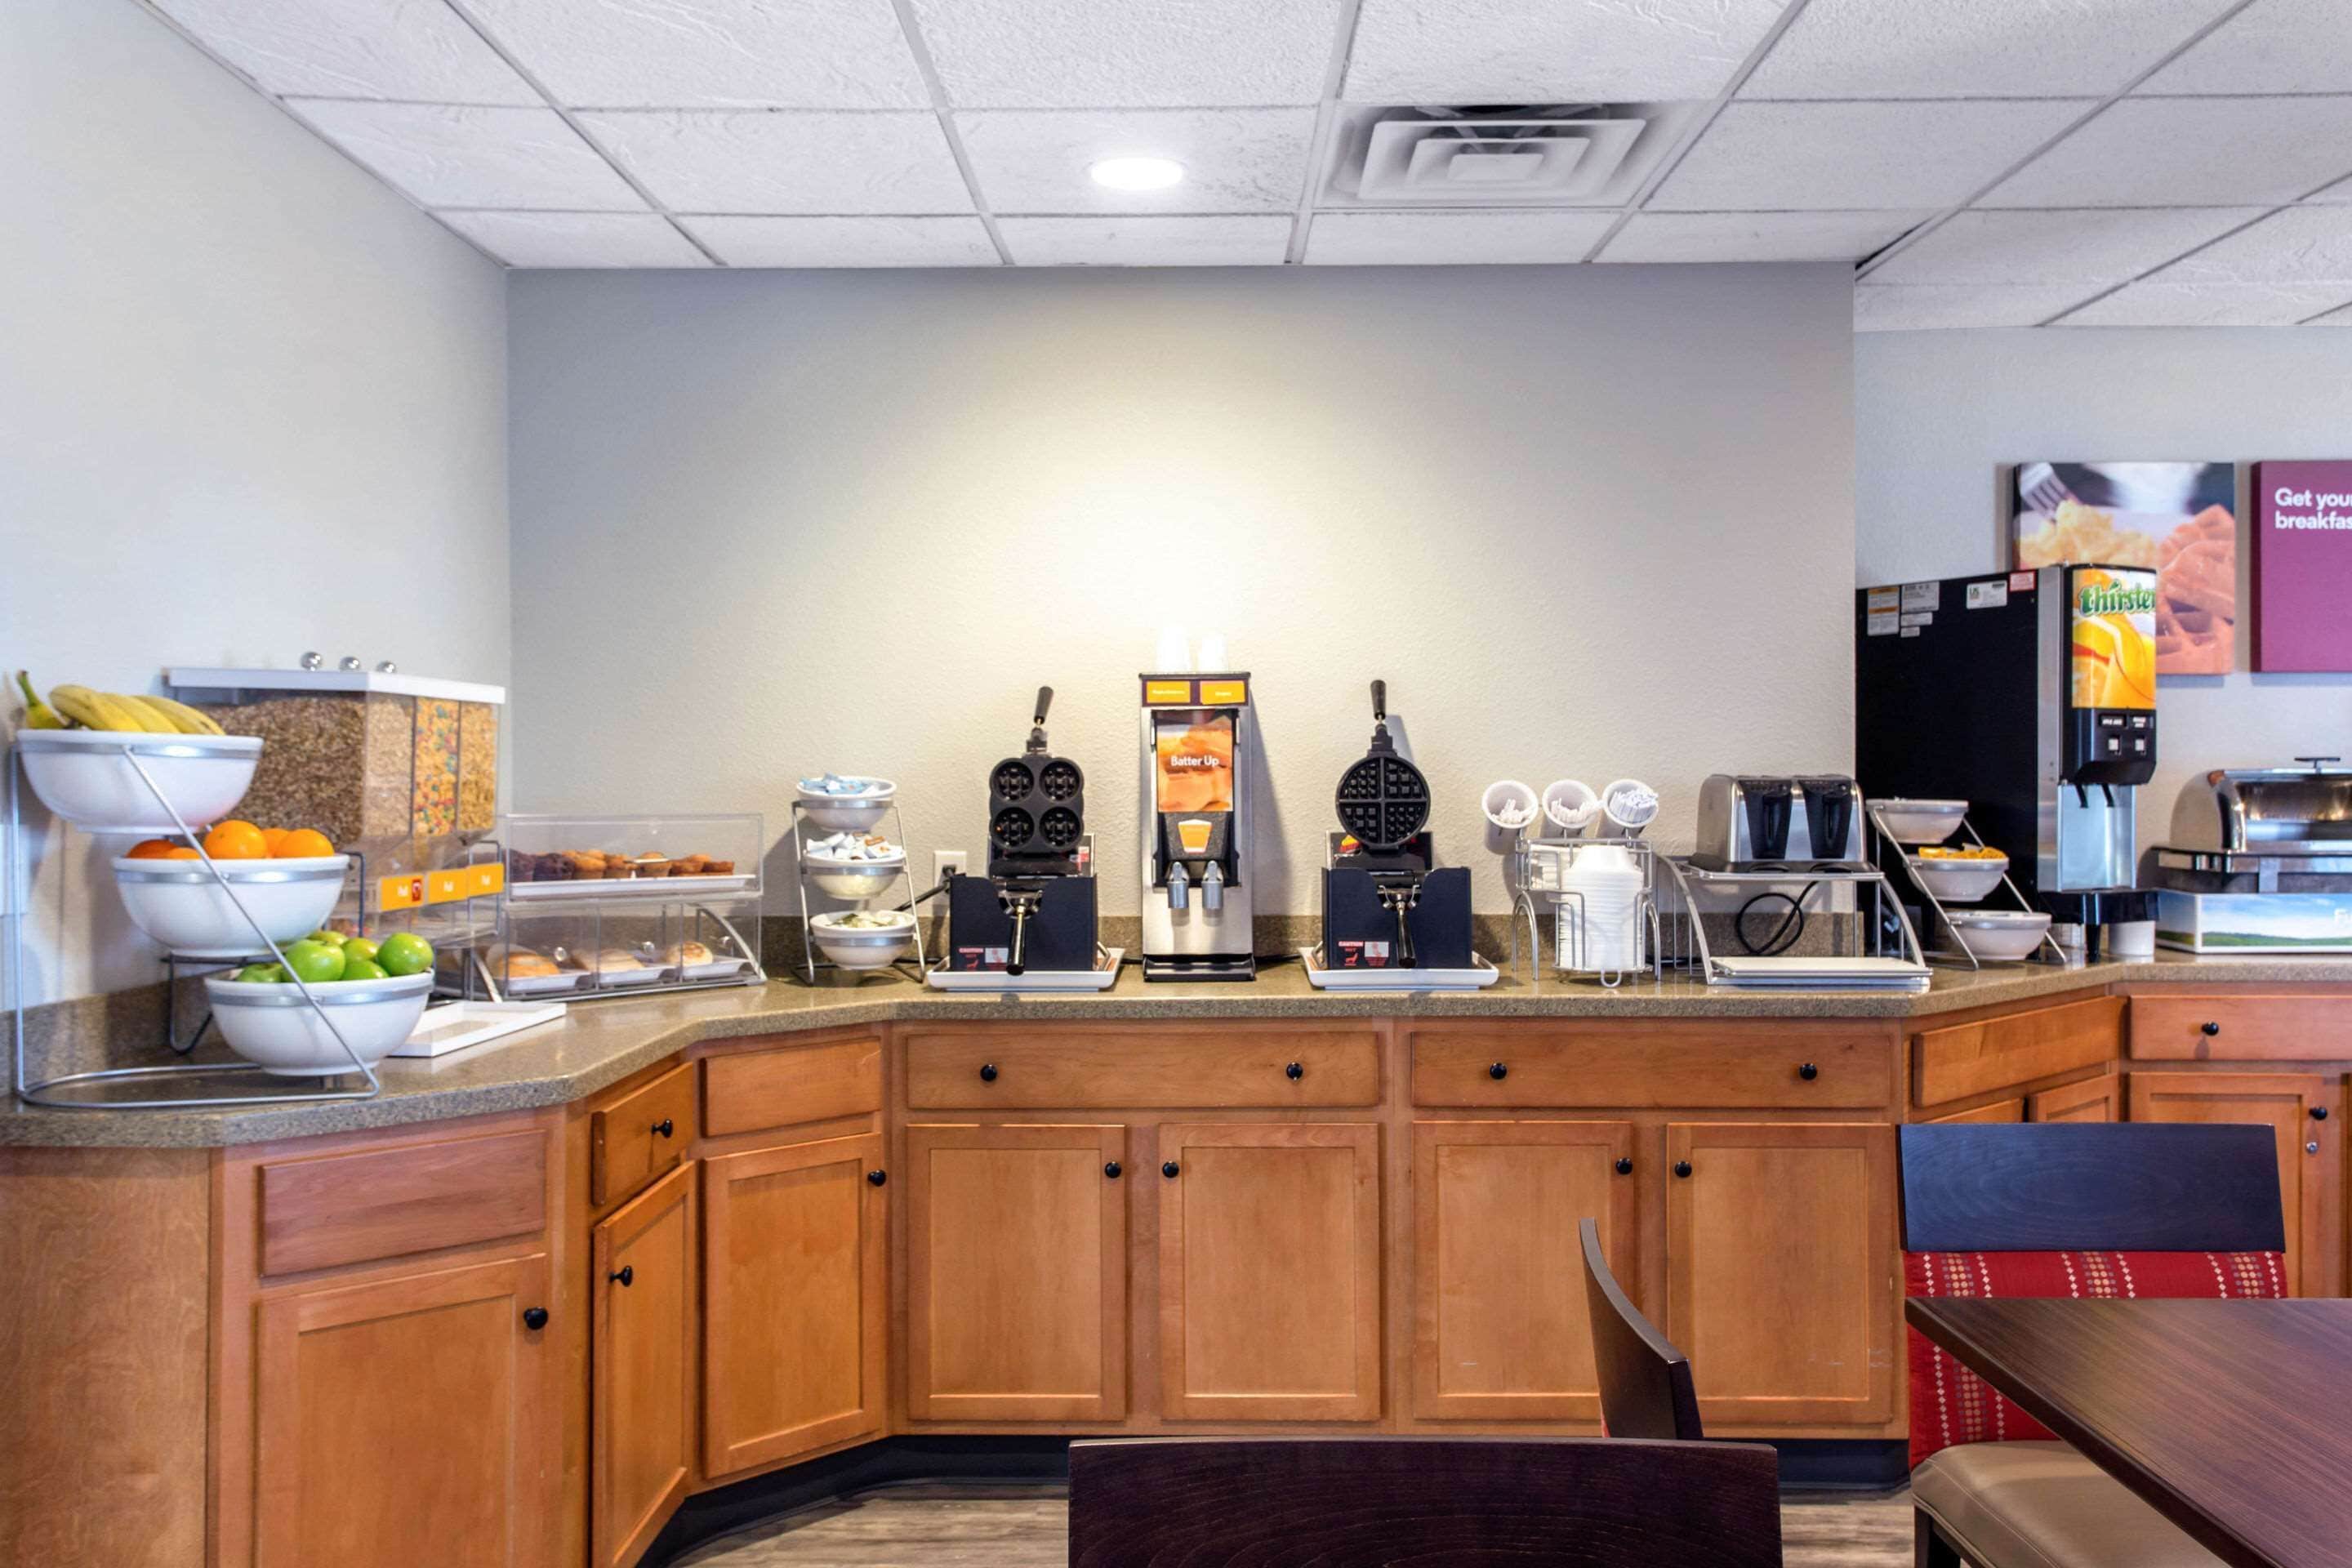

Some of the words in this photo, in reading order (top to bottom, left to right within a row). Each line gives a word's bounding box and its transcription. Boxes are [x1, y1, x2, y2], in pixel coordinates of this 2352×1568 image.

[2274, 487, 2313, 507] Get
[2315, 492, 2352, 510] you
[1170, 755, 1203, 766] Batter
[1204, 754, 1219, 767] Up
